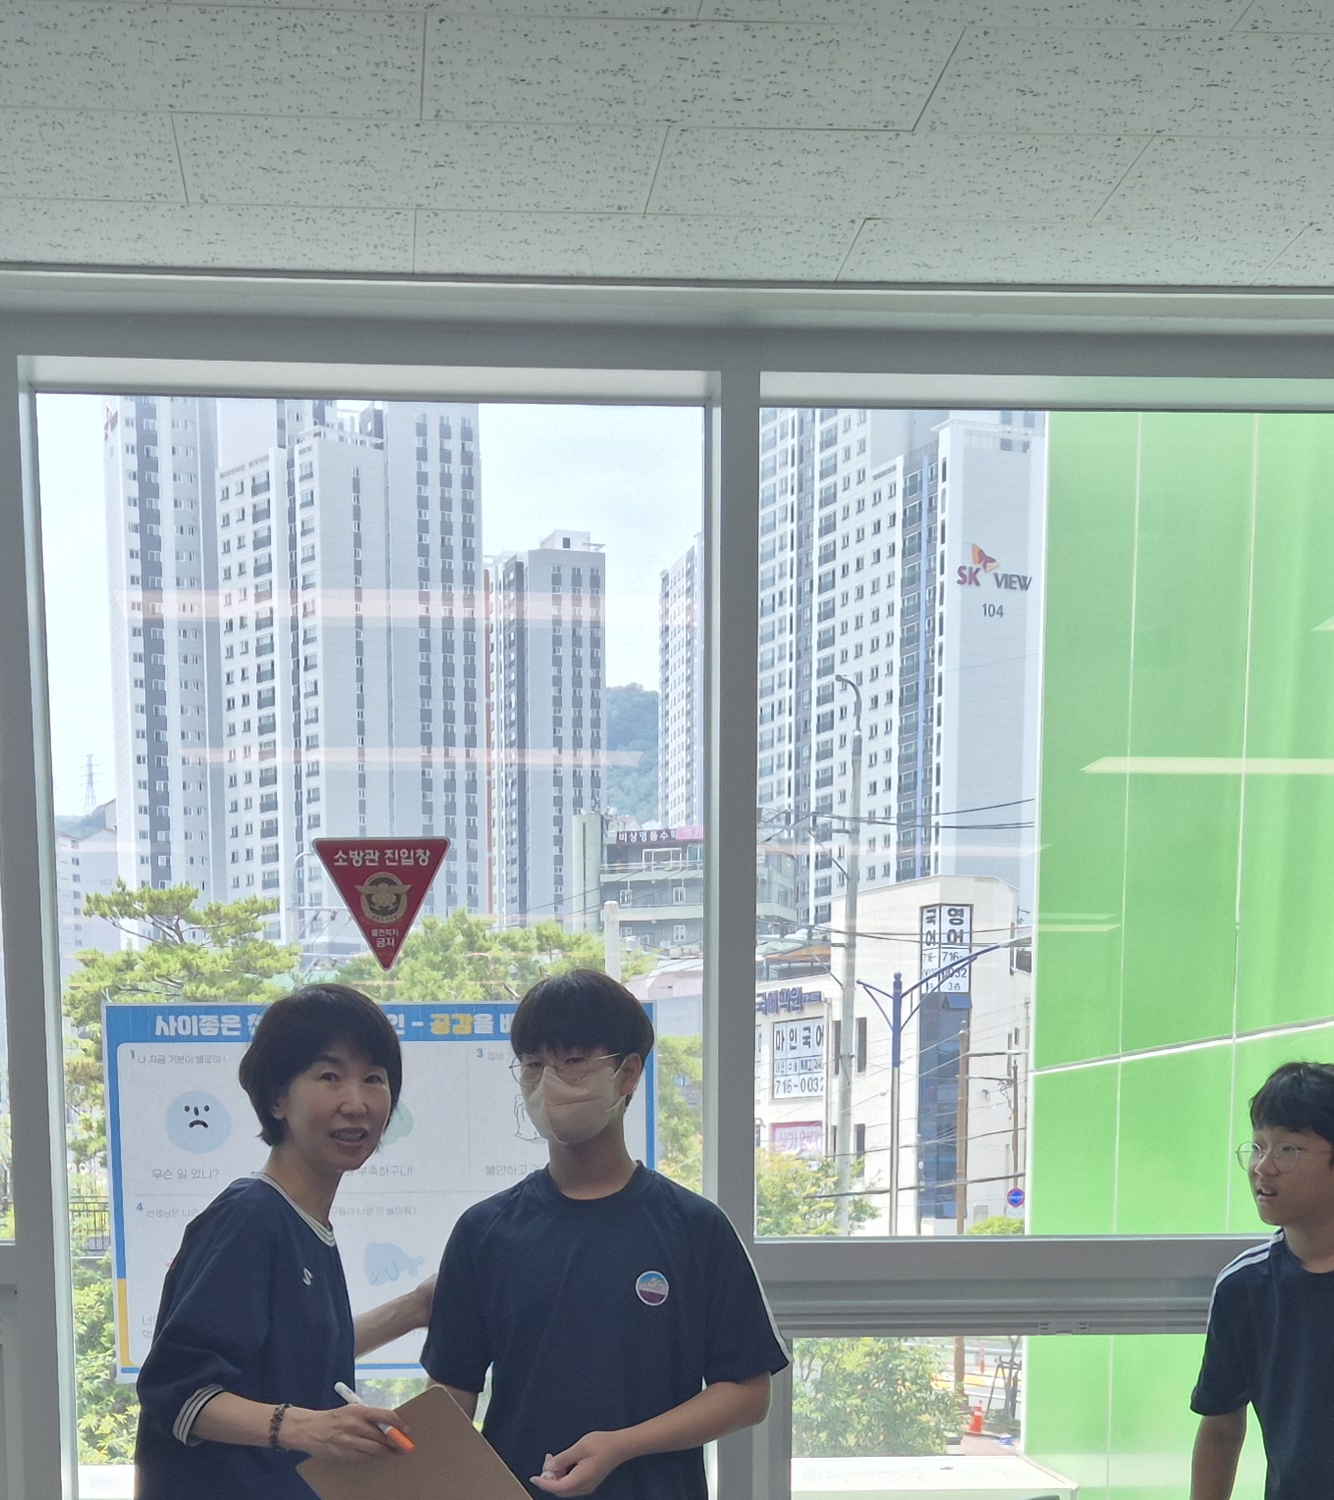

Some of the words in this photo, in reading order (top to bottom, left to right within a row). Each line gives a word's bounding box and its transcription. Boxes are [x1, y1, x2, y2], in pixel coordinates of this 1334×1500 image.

[956, 565, 981, 587] SK
[993, 572, 1032, 591] VIEW
[982, 603, 1004, 618] 104
[333, 849, 380, 867] 소방관
[384, 848, 430, 867] 진입창
[376, 937, 395, 947] 금지
[155, 1014, 241, 1036] 사이좋은
[430, 1013, 494, 1035] 공감을
[476, 1048, 484, 1058] 3
[148, 1055, 165, 1064] 지금
[168, 1055, 193, 1064] 기분이
[152, 1169, 173, 1180] 무슨
[177, 1169, 187, 1179] 일
[191, 1168, 220, 1180] 있니?
[136, 1202, 144, 1212] 4
